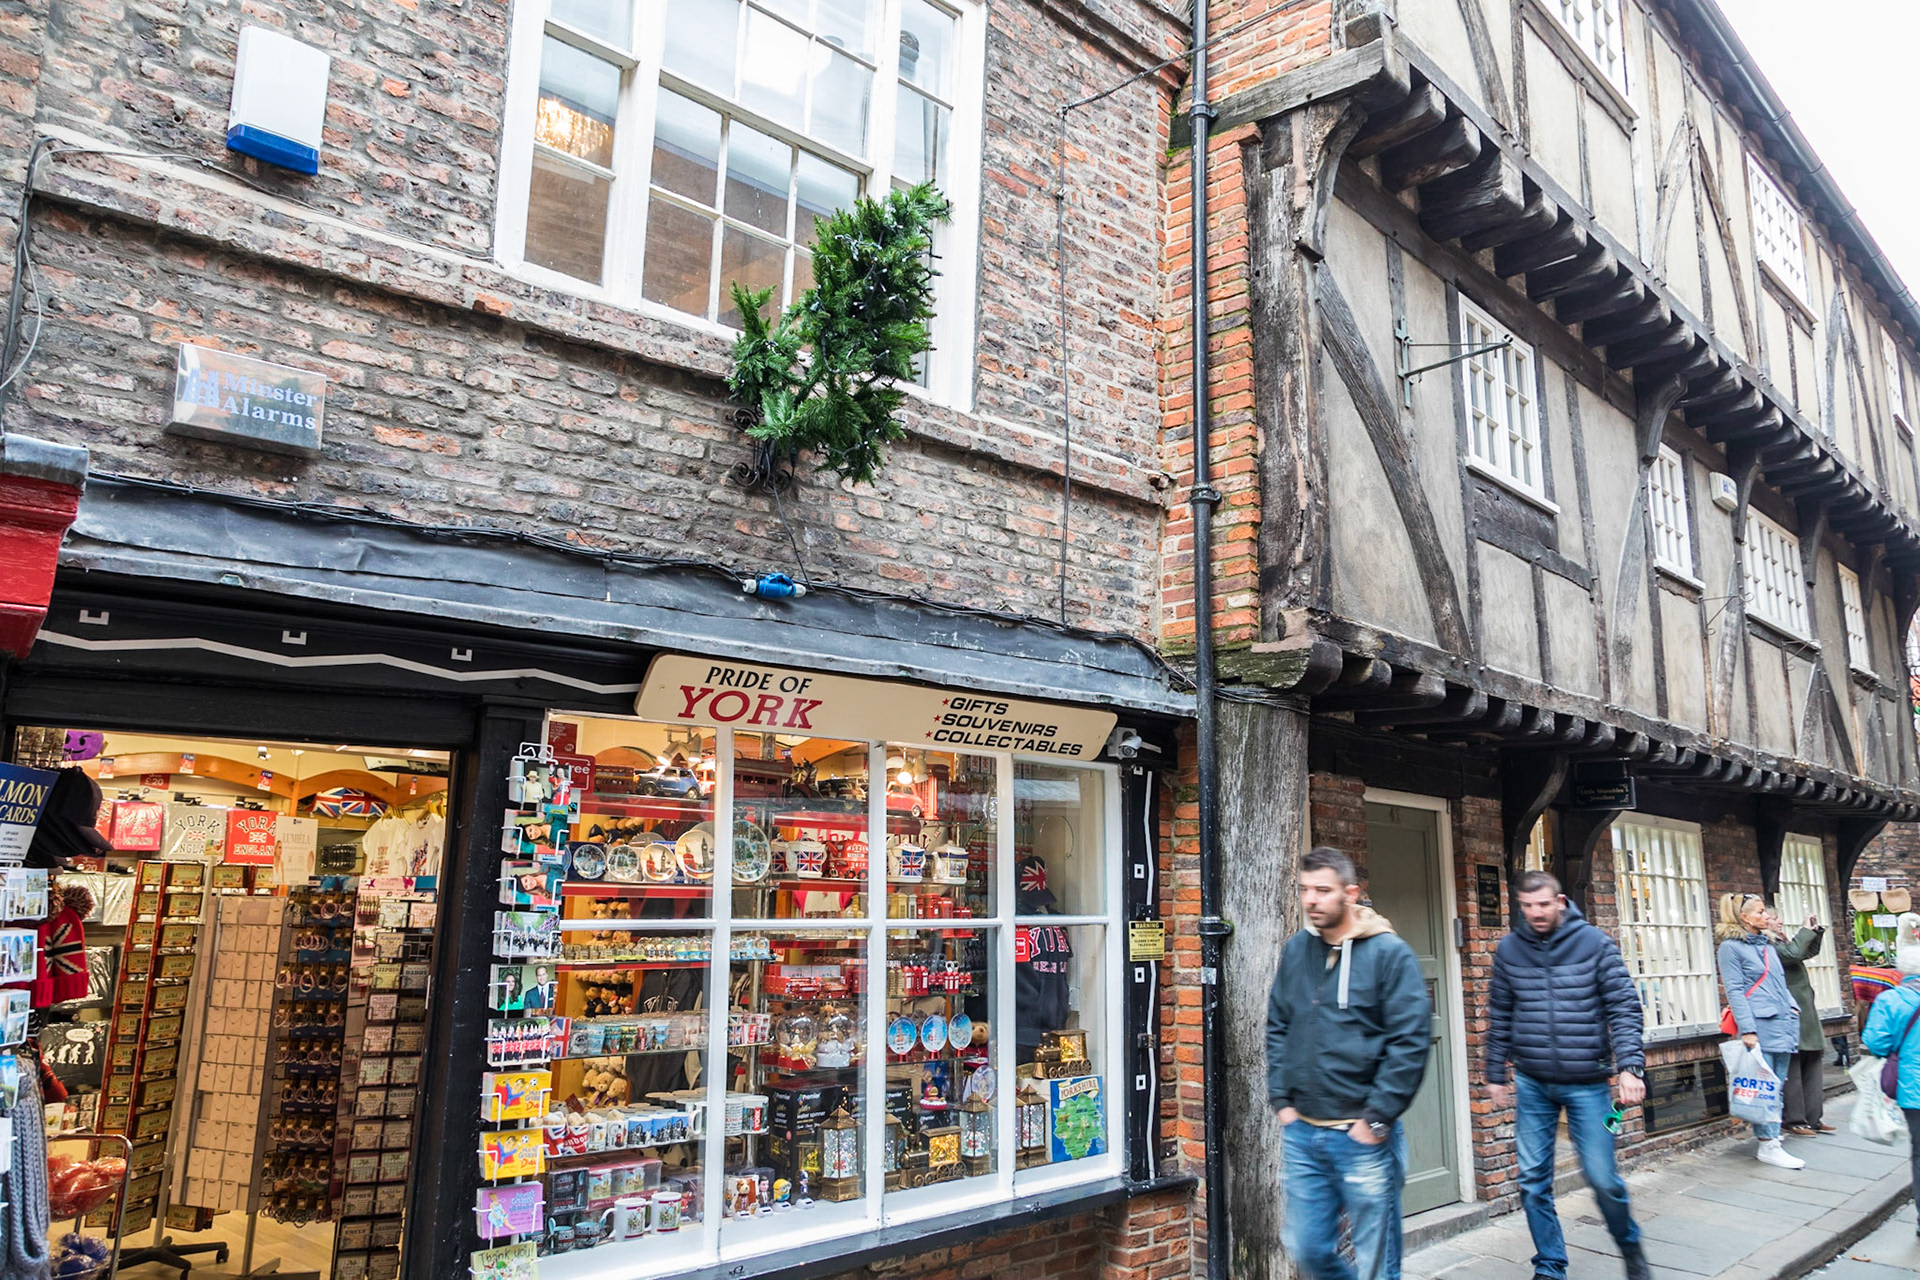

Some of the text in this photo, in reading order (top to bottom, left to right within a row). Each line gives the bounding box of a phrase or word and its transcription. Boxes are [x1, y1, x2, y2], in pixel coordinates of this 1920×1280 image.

[222, 372, 318, 407] Minster
[220, 396, 317, 429] Alarms
[705, 666, 813, 694] PRIDE OF
[677, 685, 823, 729] YORK
[950, 697, 1009, 715] GIFTS
[941, 713, 1058, 737] SOUVENIRS
[933, 729, 1083, 755] COLLECTABLES
[0, 804, 38, 824] CARDS
[175, 815, 220, 834] YORK
[1061, 1079, 1097, 1099] YORKSHIRE
[479, 1242, 535, 1266] Thank you!
